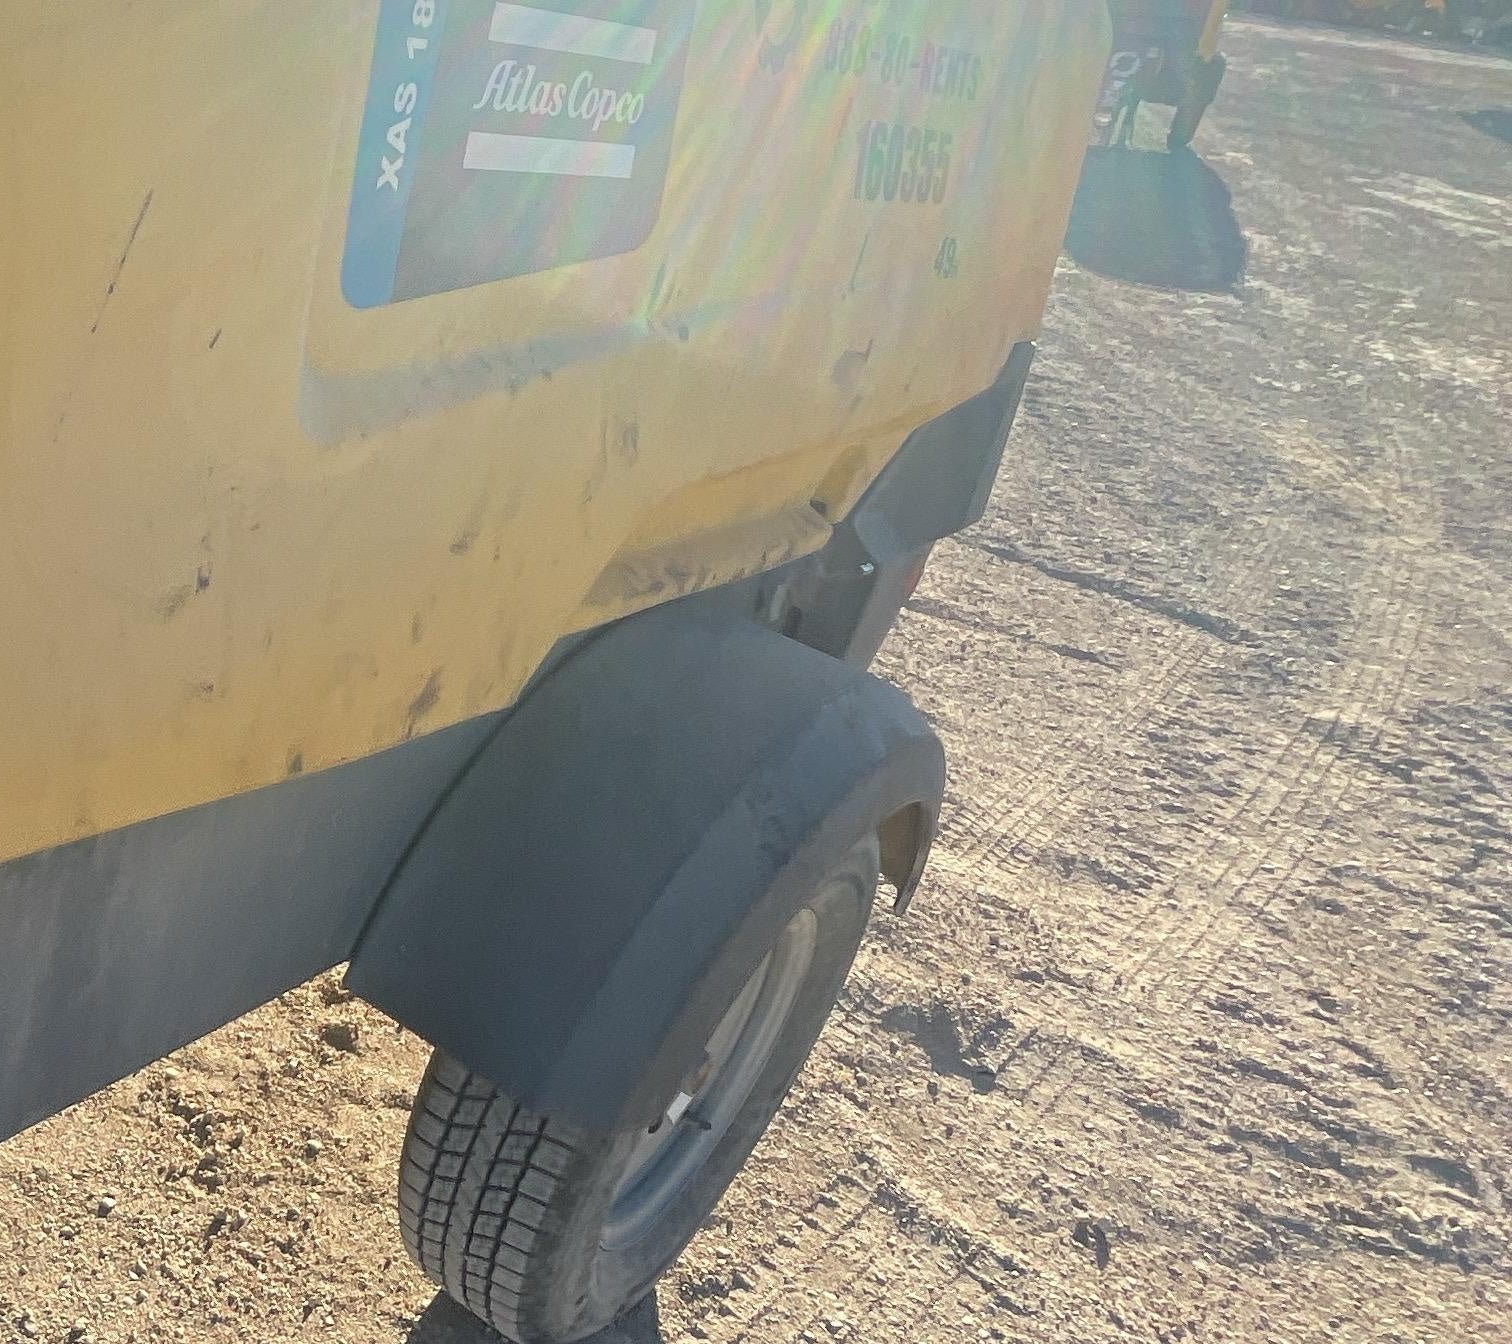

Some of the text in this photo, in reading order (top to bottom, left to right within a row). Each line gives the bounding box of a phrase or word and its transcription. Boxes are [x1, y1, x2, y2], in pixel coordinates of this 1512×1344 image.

[375, 80, 418, 192] XAS
[472, 58, 646, 131] Atlas Copco
